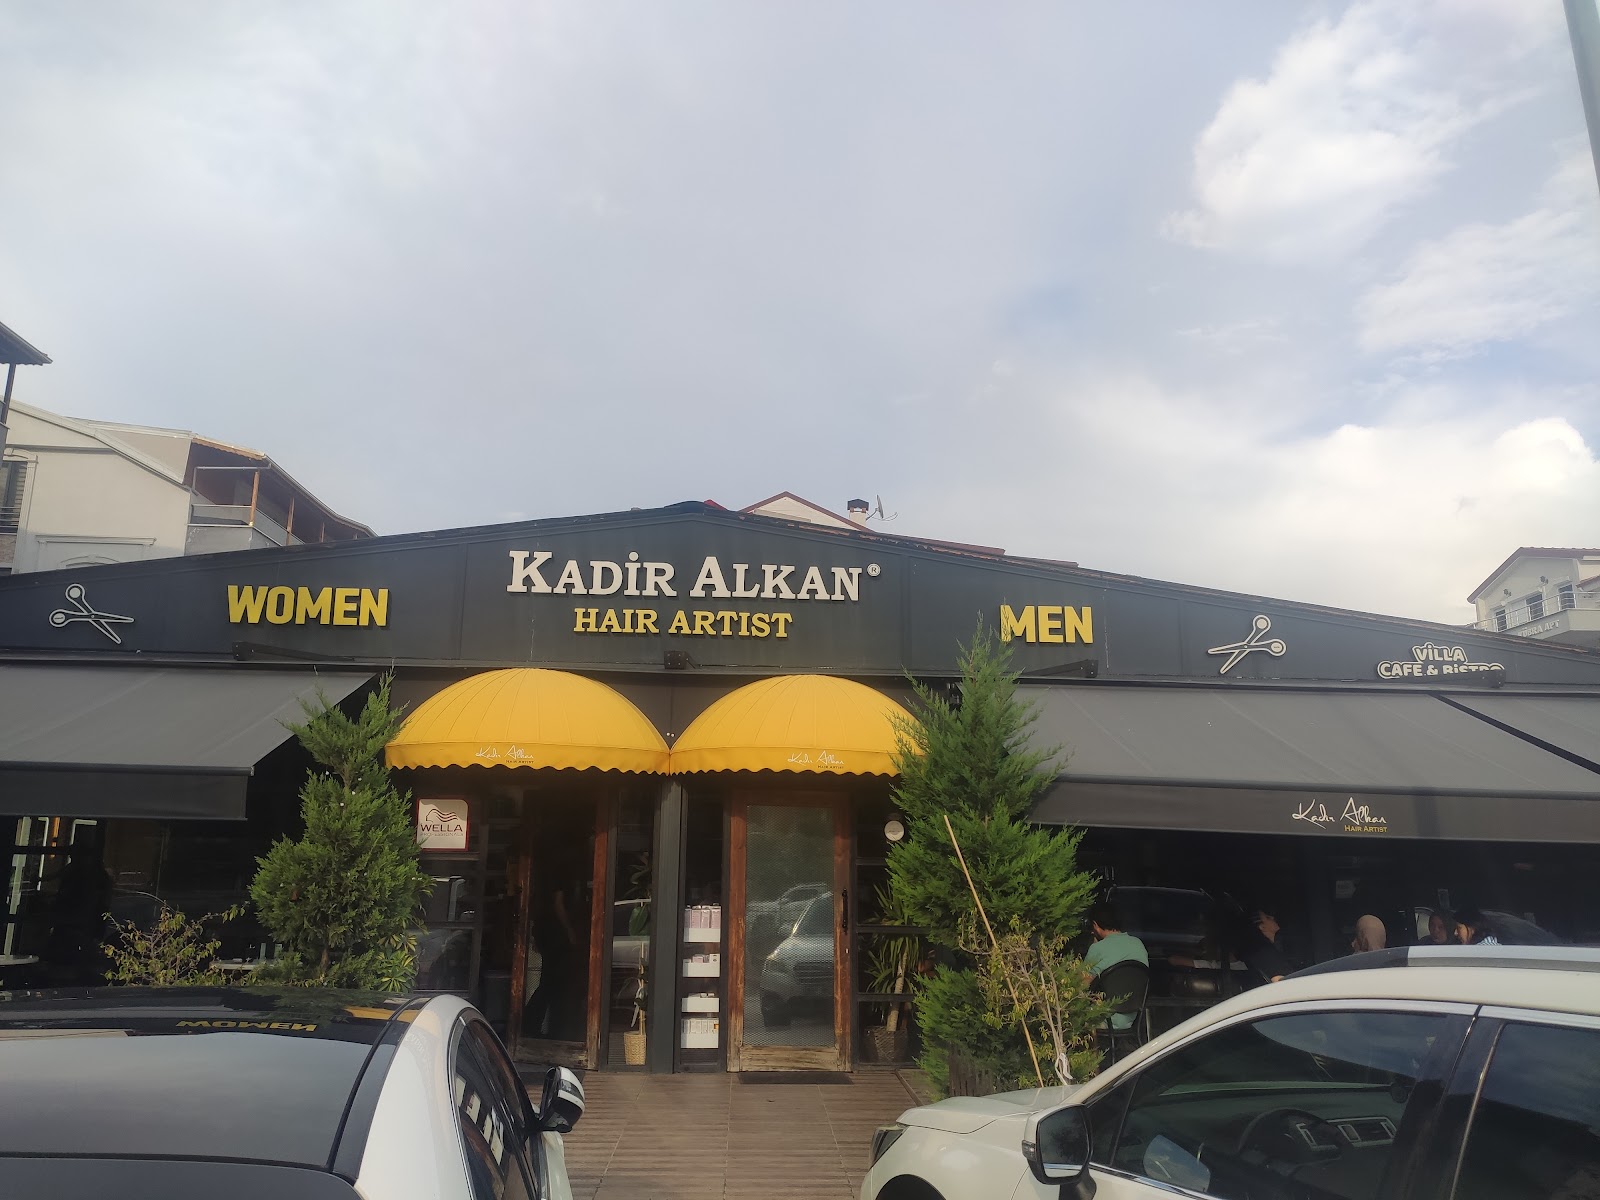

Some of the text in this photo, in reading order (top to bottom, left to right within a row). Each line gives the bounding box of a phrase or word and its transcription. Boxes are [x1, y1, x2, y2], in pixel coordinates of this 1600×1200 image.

[227, 584, 390, 627] WOMEN
[573, 607, 793, 638] HAIR ARTIST
[1000, 604, 1094, 644] MEN
[1380, 662, 1423, 677] CAFE
[1426, 664, 1439, 676] &
[420, 823, 464, 832] WELLA
